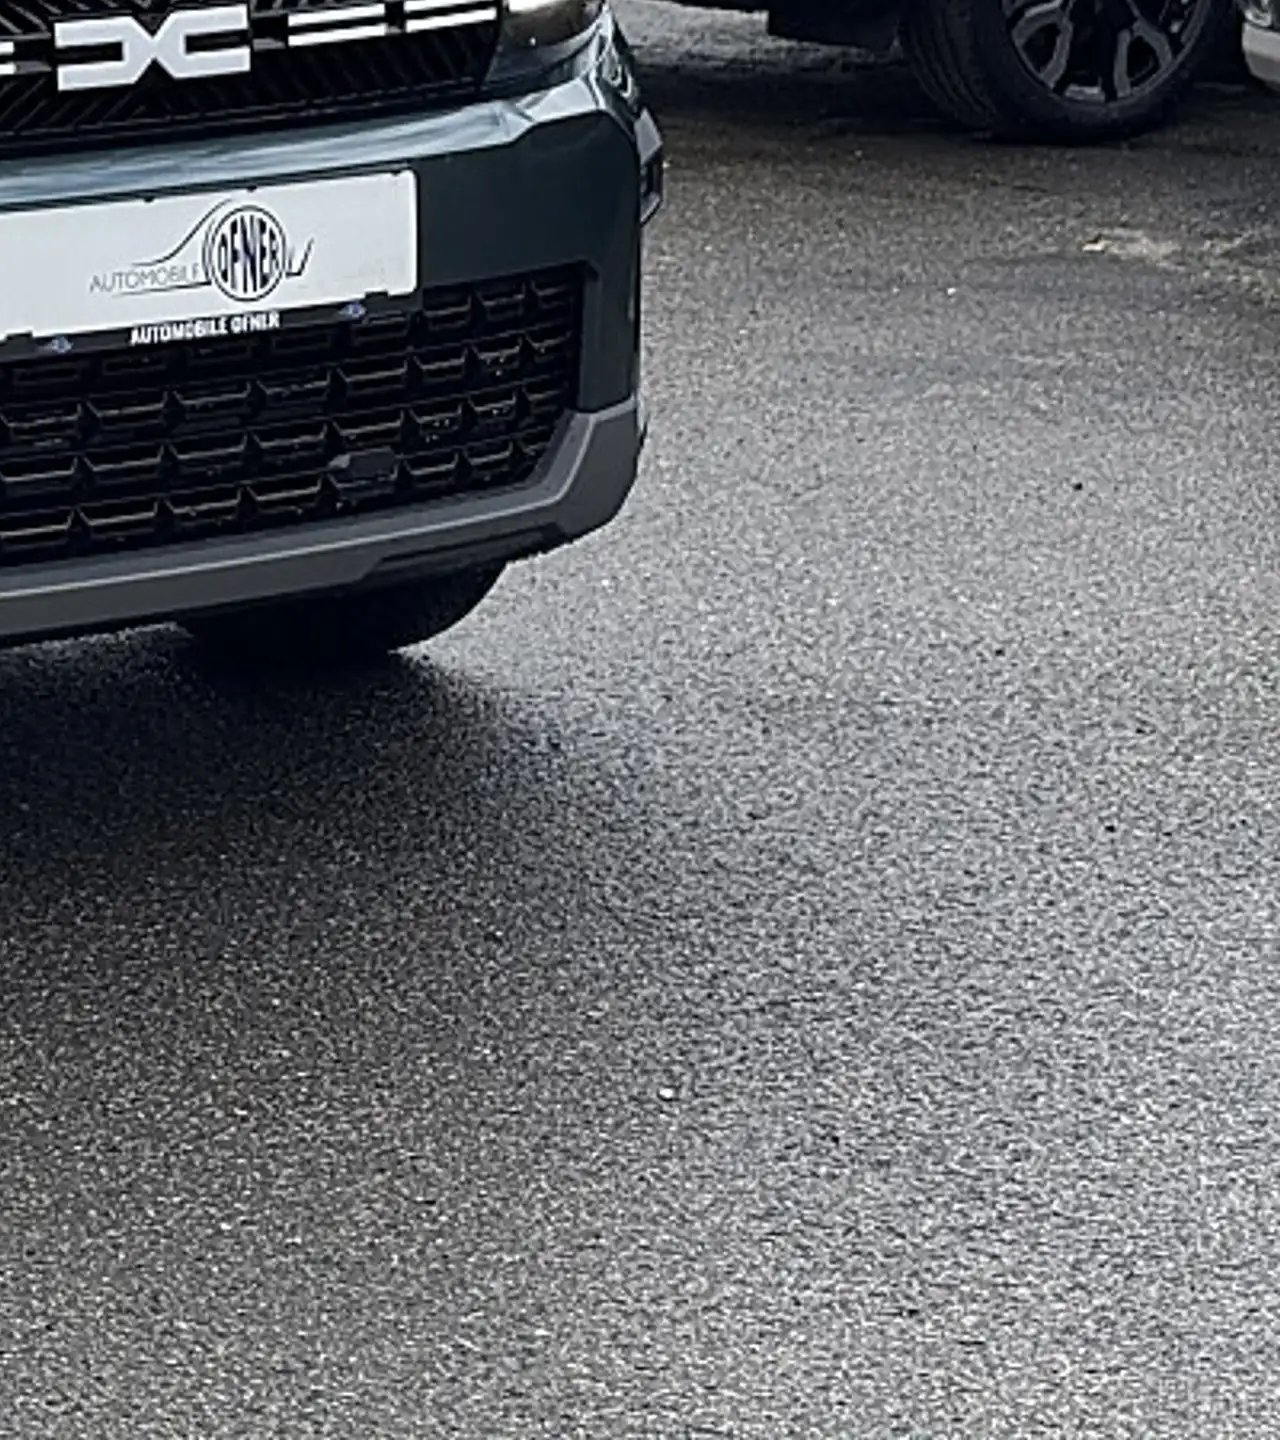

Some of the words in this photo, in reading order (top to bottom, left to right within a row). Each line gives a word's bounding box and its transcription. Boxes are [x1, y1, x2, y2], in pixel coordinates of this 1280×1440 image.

[217, 214, 280, 294] OFNER
[130, 317, 229, 346] AUTOMOBILE
[230, 311, 280, 334] OFNER
